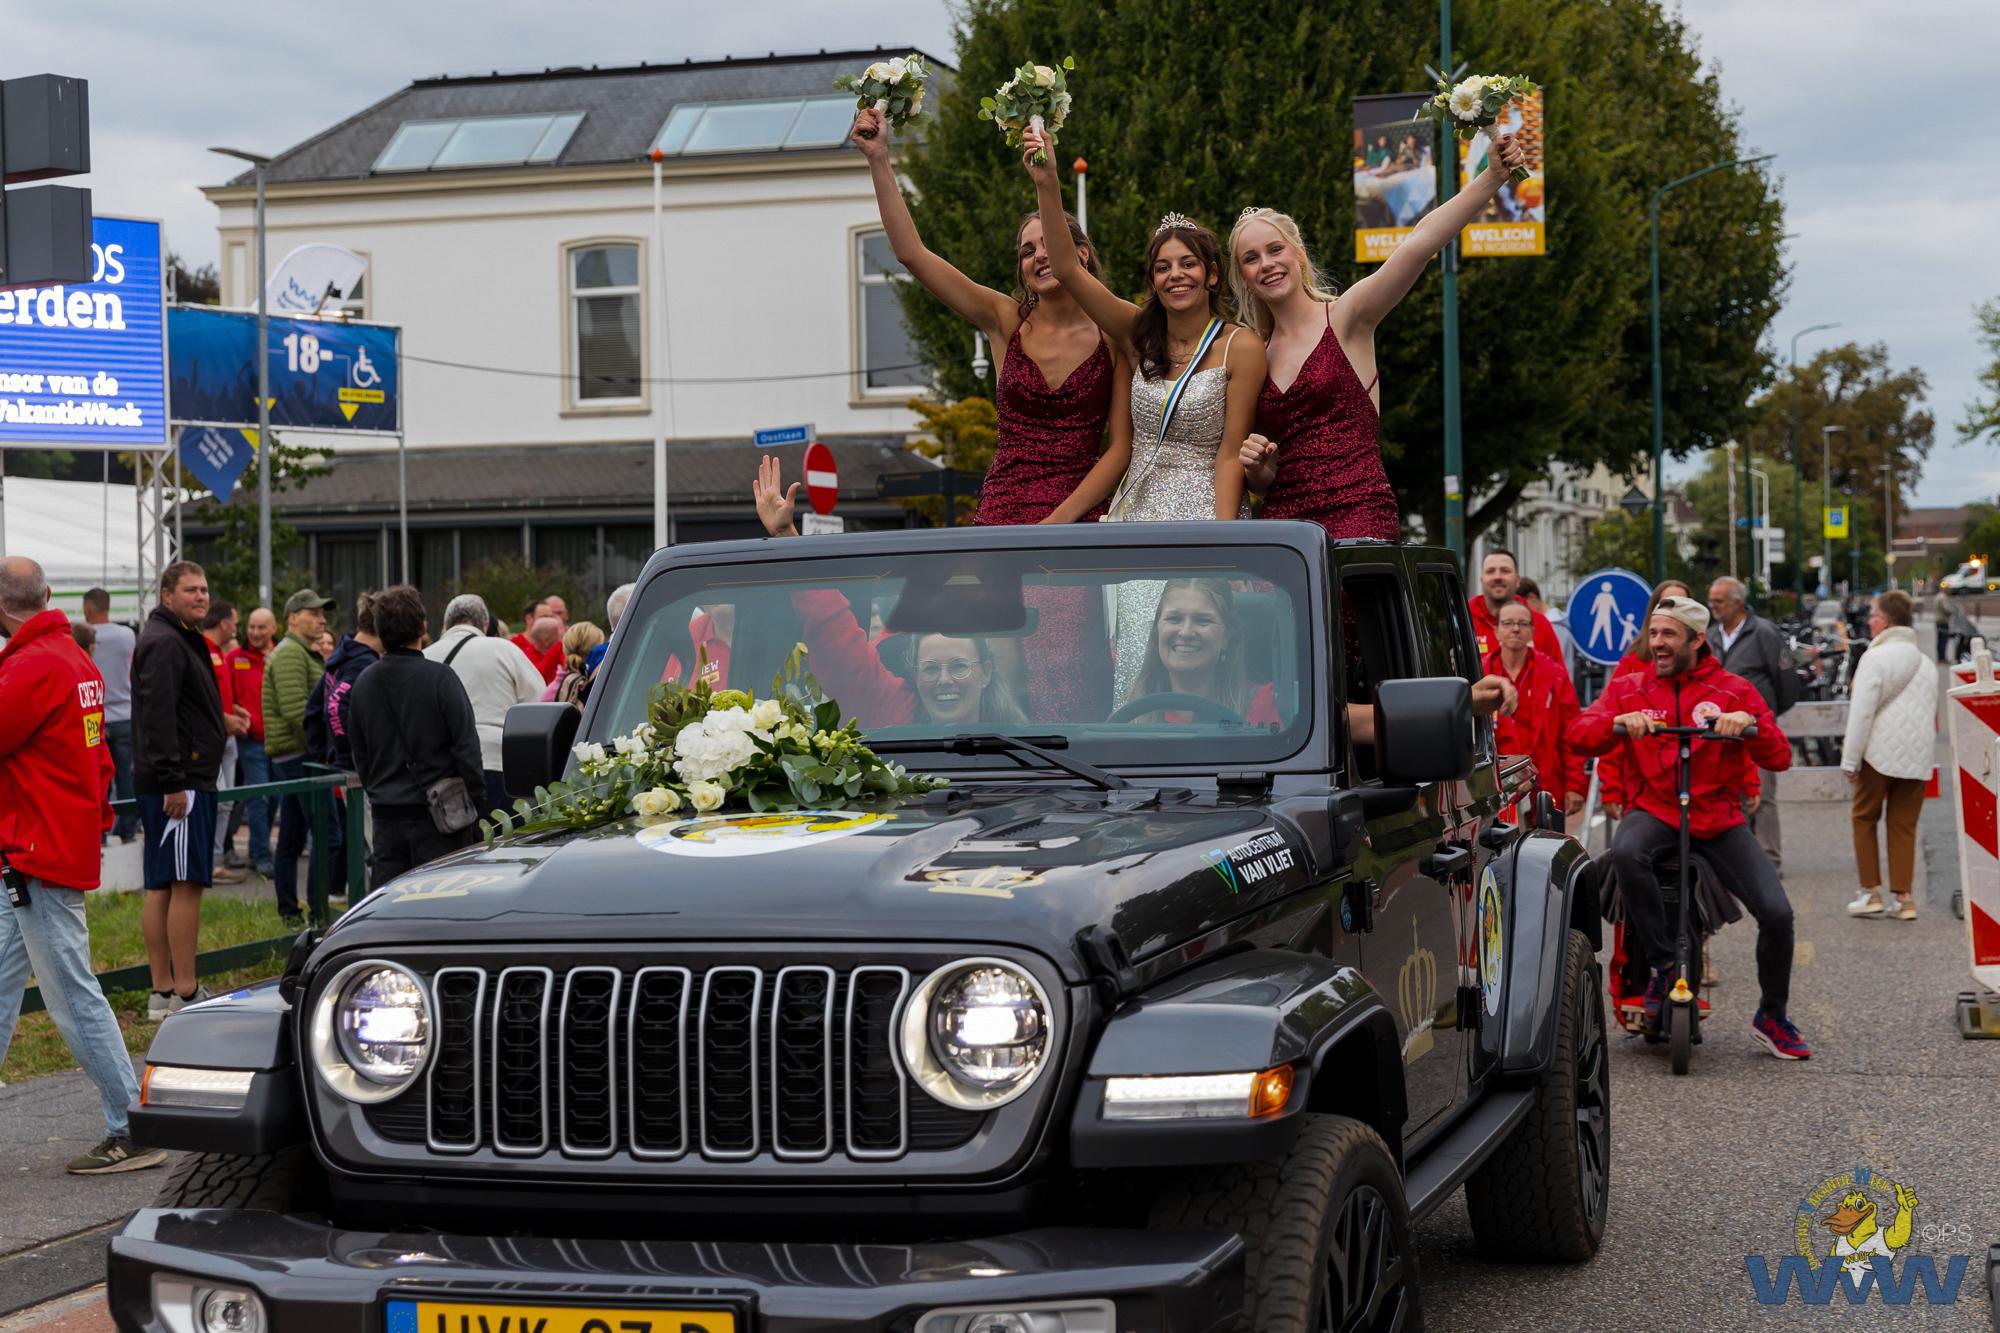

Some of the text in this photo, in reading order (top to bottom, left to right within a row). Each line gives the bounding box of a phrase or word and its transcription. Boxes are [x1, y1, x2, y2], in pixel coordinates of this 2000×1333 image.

[1470, 228, 1535, 242] WELKOM
[284, 333, 333, 374] 18-
[47, 375, 90, 394] van
[92, 371, 119, 396] de
[1227, 831, 1286, 863] AUTOCENTRUM
[1238, 848, 1295, 884] VAN VLIET
